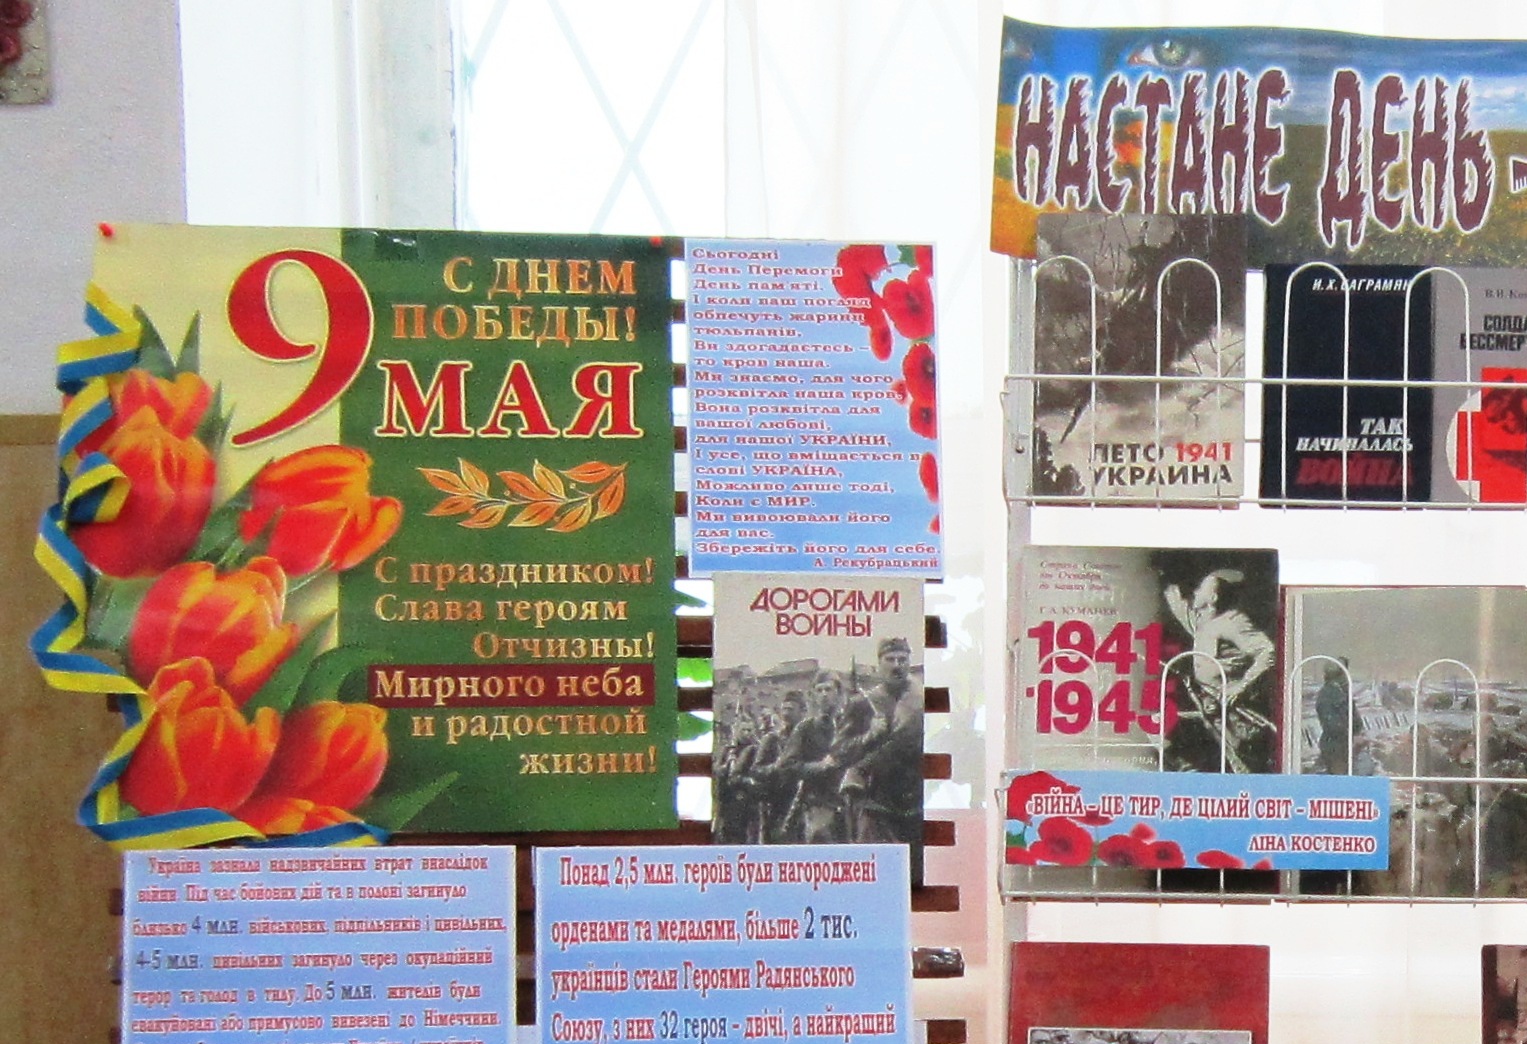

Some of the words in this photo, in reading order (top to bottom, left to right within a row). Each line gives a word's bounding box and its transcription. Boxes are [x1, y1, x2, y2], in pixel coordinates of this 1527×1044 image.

[1013, 68, 1289, 224] НАСТАНЕ
[1318, 68, 1495, 250] ДЕНЬ
[443, 259, 473, 292] С
[487, 257, 637, 298] ДНЕМ
[693, 264, 741, 276] День
[392, 304, 637, 347] ПОБЕДЫ!
[227, 249, 373, 446] 9
[376, 360, 643, 438] МАЯ
[801, 435, 892, 447] УКРАЇНИ,
[1360, 419, 1407, 435] ТАК
[1176, 442, 1232, 462] 1941
[752, 465, 843, 477] УКРАЇНА,
[1092, 465, 1233, 486] УКРАИНА
[374, 558, 395, 583] С
[410, 558, 654, 591] праздником!
[375, 596, 481, 621] Слава
[496, 601, 627, 627] героям
[750, 588, 900, 613] ДОРОГАМИ
[776, 611, 872, 637] ВОЙНЫ
[472, 632, 654, 659] Отчизны!
[1028, 621, 1163, 674] 1941
[375, 671, 545, 704] Мирного
[556, 668, 643, 698] неба
[1026, 679, 1177, 734] 1945
[411, 713, 435, 736] и
[447, 707, 646, 742] радостной
[519, 748, 656, 774] жизни!
[1101, 794, 1124, 815] ЦЕ
[1130, 795, 1164, 819] ТИР,
[1170, 797, 1193, 819] ДЕ
[1198, 792, 1250, 822] ЦІЛИЙ
[1255, 799, 1291, 819] СВІТ
[1249, 835, 1285, 852] ЛІНА
[1291, 835, 1376, 852] КОСТЕНКО
[560, 857, 608, 886] Понад
[614, 857, 638, 889] 2,5
[643, 862, 679, 885] млн.
[684, 857, 731, 891] героїв
[738, 854, 772, 891] були
[779, 854, 876, 888] нагороджені
[552, 917, 629, 950] орденами
[635, 921, 651, 941] та
[658, 918, 741, 945] медалями,
[745, 911, 799, 939] більше
[804, 907, 814, 938] 2
[820, 913, 857, 938] тис.
[551, 963, 628, 999] українців
[634, 967, 678, 989] стали
[683, 961, 750, 998] Героями
[756, 960, 854, 987] Радянського
